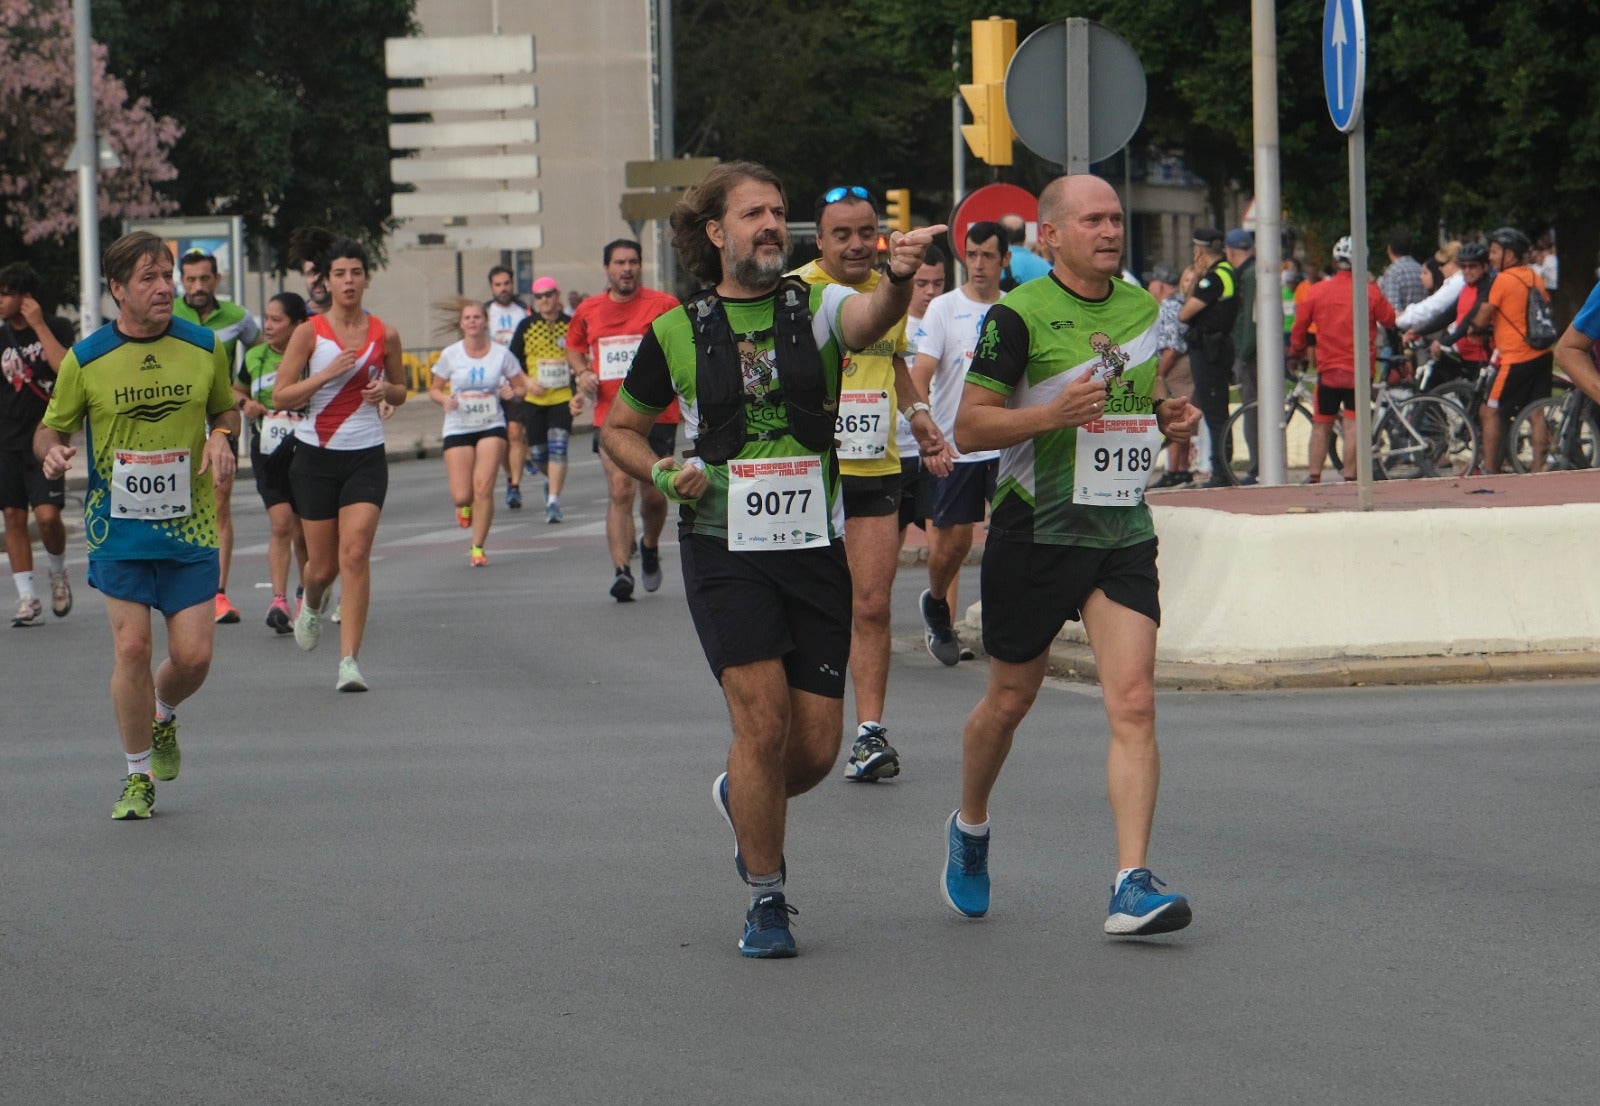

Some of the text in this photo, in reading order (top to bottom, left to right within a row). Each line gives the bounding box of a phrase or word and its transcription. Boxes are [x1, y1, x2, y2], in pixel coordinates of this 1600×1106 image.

[114, 380, 193, 405] Htrainer
[834, 414, 881, 433] 3657
[731, 463, 755, 478] 42
[1094, 447, 1152, 472] 9189
[126, 473, 176, 494] 6061
[746, 489, 812, 516] 9077
